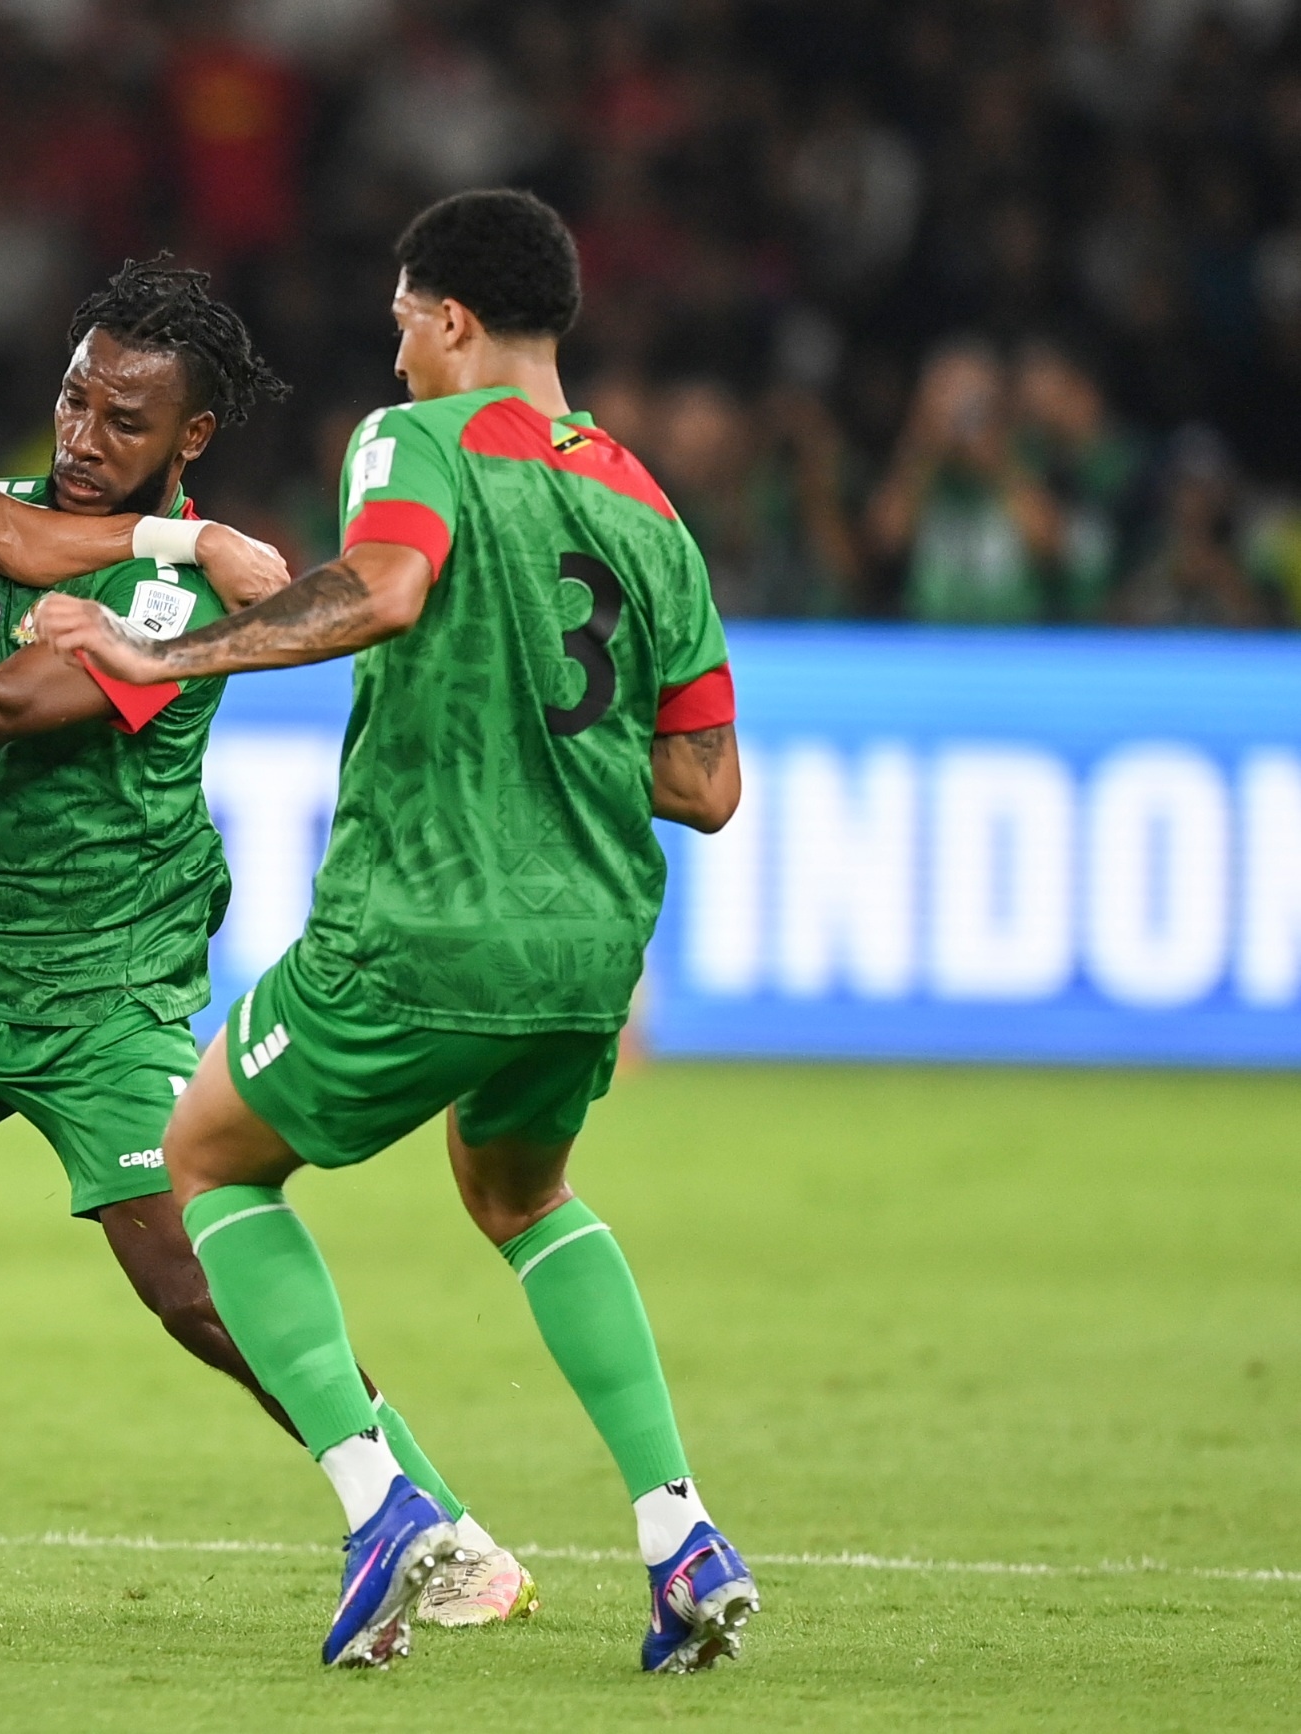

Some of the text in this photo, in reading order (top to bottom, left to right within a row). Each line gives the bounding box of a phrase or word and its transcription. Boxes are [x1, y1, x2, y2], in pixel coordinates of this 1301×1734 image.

[146, 597, 180, 617] UNITES
[148, 589, 181, 606] FOOTBALL
[546, 551, 624, 736] 3
[118, 1147, 164, 1169] cape
